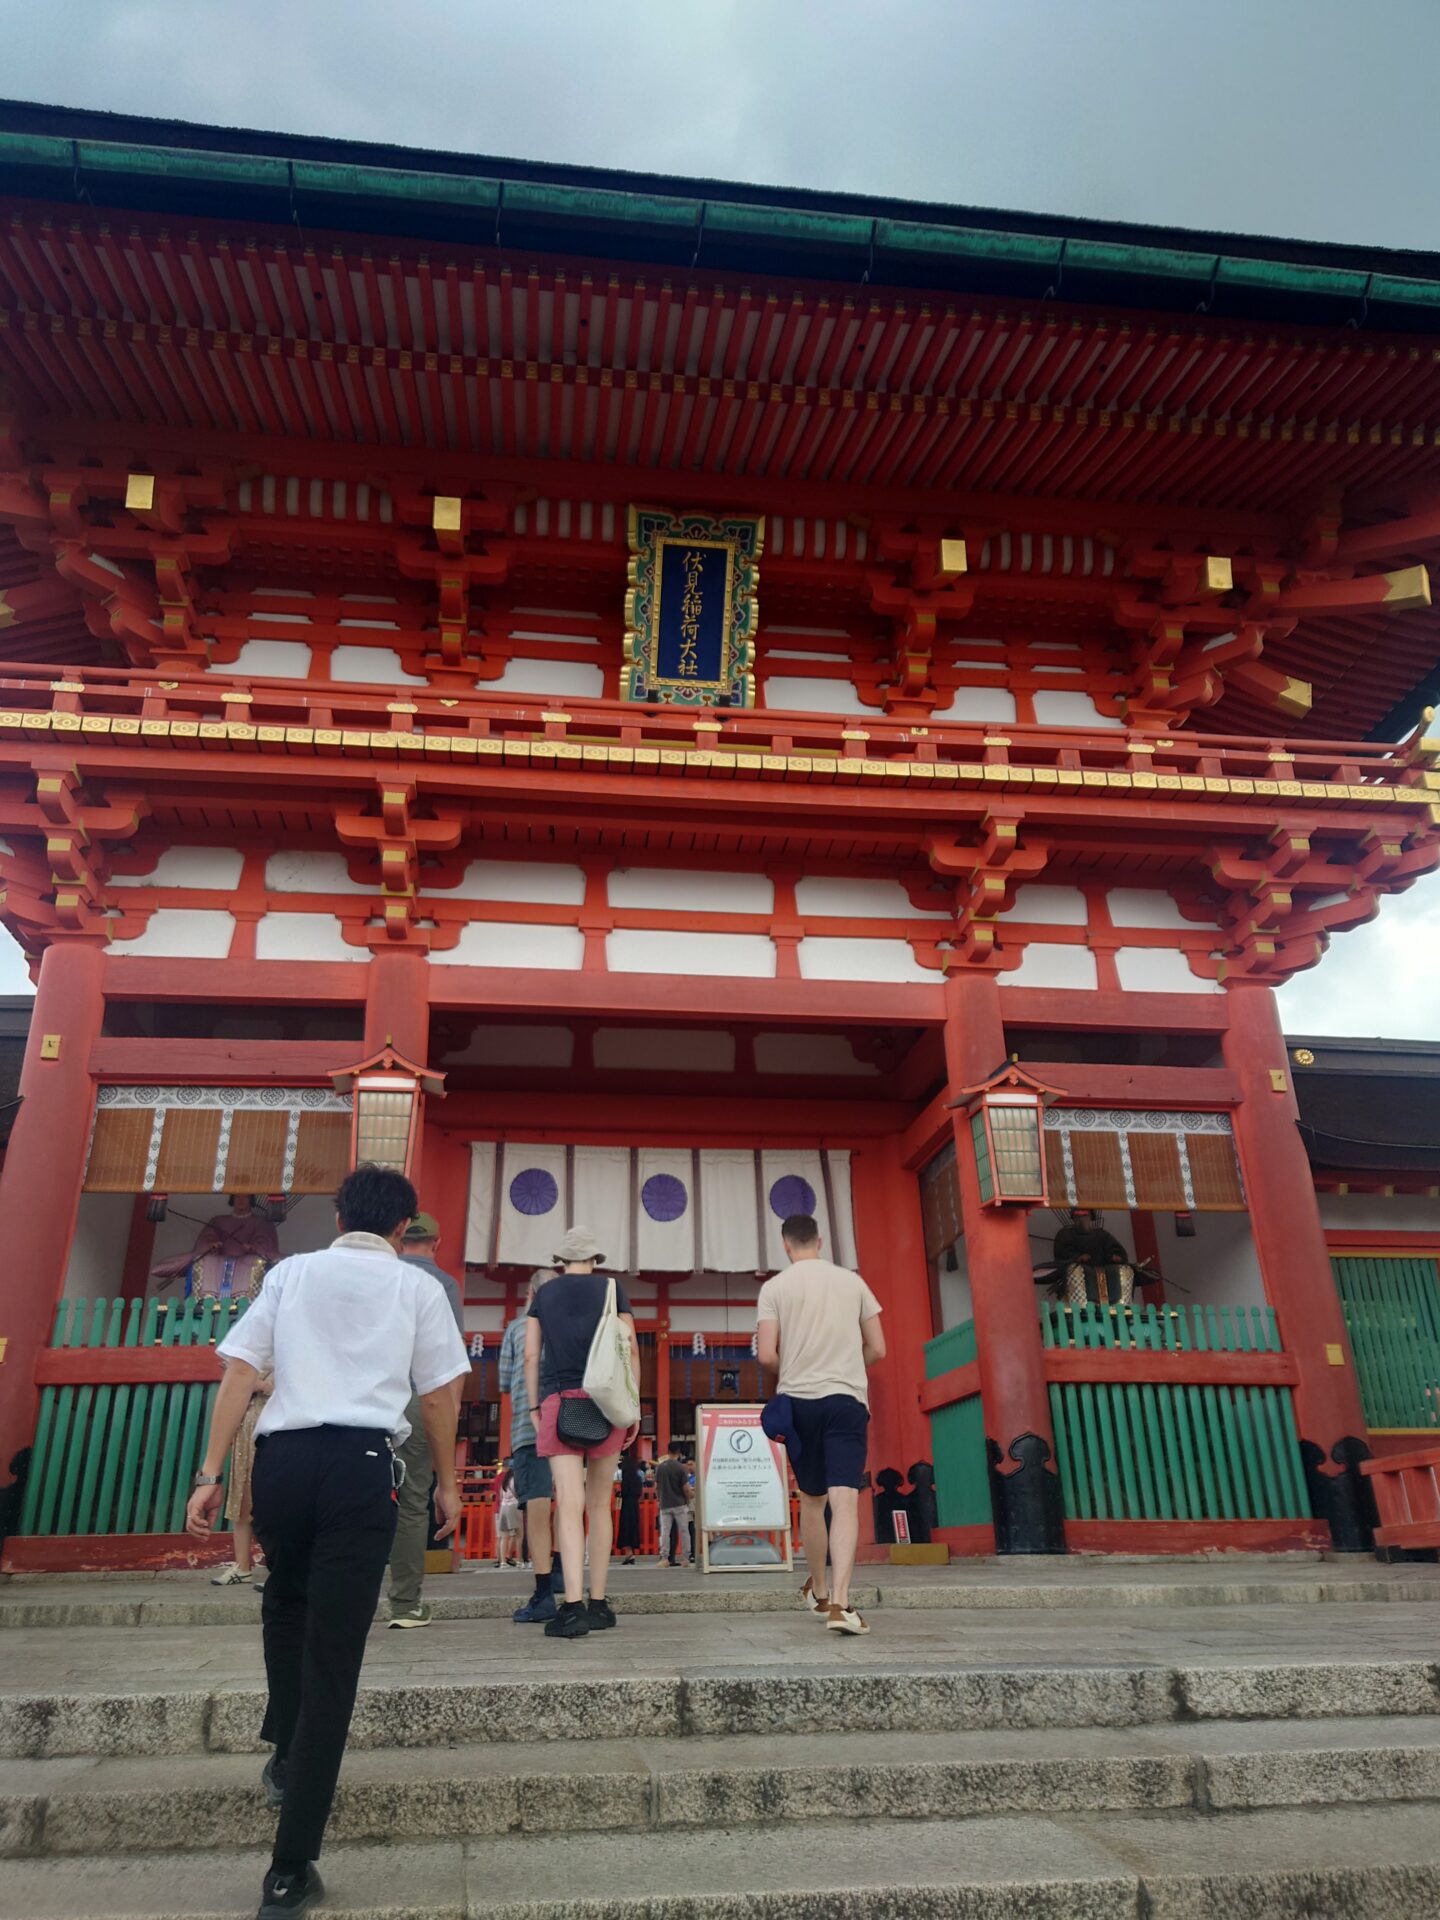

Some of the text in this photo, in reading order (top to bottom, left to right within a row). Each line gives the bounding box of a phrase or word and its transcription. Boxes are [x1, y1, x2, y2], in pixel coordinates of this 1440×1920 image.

[678, 551, 706, 676] 伏見稲荷大社
